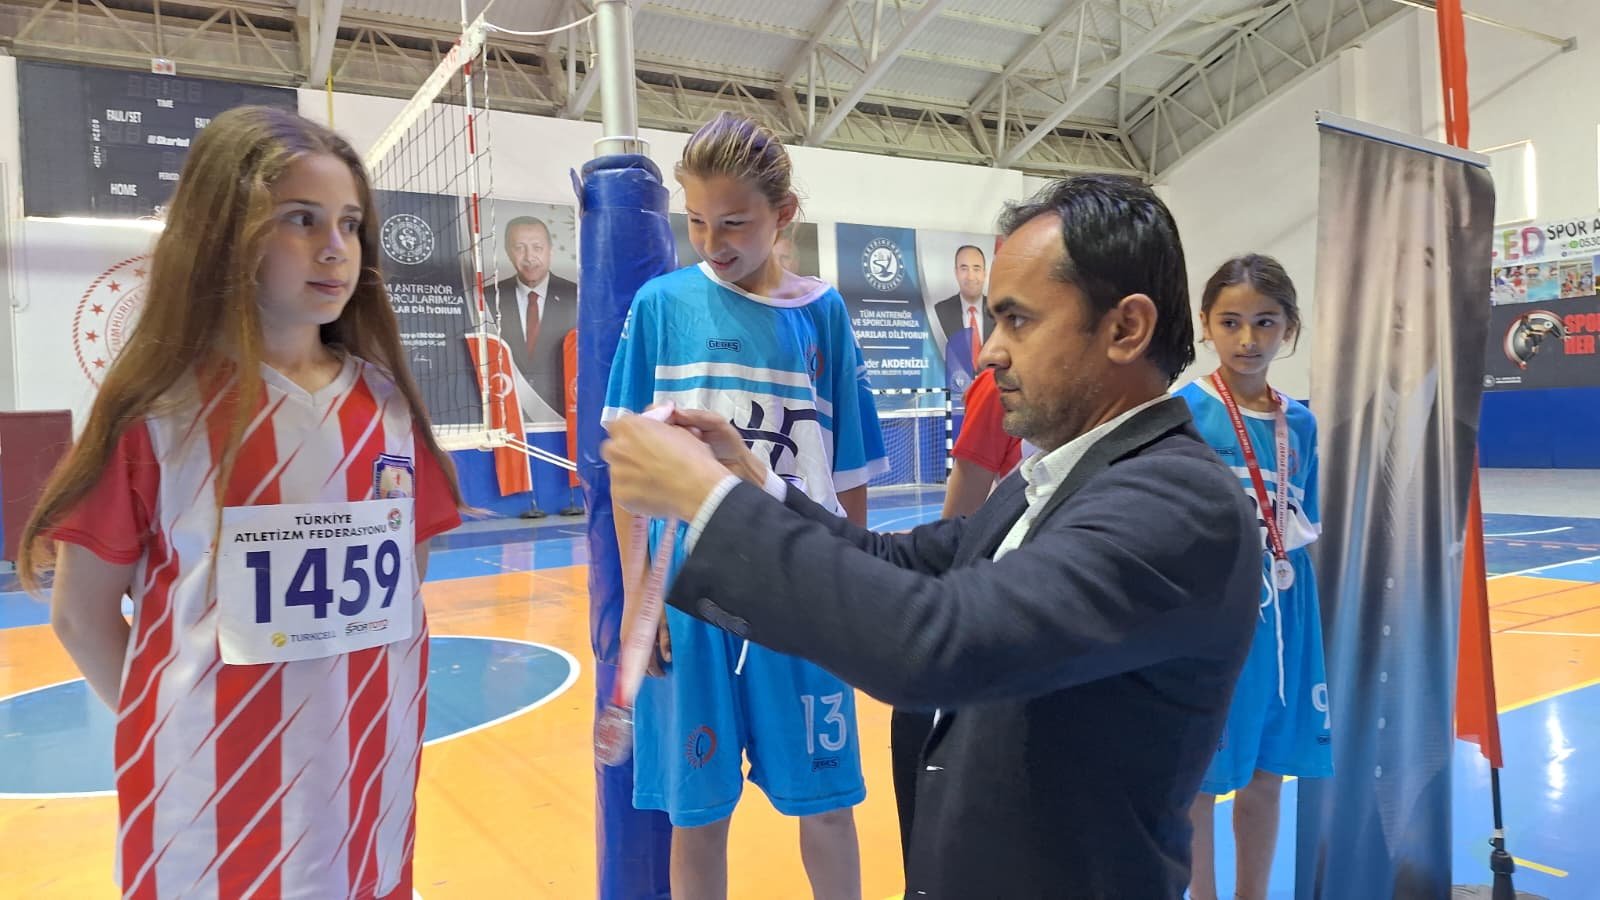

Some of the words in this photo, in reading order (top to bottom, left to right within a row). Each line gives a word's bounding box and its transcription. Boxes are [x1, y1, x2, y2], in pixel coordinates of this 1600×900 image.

[110, 183, 137, 196] HOME
[1547, 221, 1587, 240] SPOR
[395, 284, 453, 294] ANTRENÖR
[387, 293, 464, 305] ORCULARIMIZA
[860, 309, 875, 318] TÜM
[876, 310, 912, 320] ANTRENÖR
[888, 329, 929, 340] DİLİYORUM
[881, 357, 929, 369] AKDENİZLİ
[295, 512, 352, 526] TÜRKİYE
[234, 528, 304, 543] ATLETİZM
[309, 524, 388, 540] FEDERASYONU
[246, 539, 401, 624] 1459
[290, 630, 337, 642] TURKCELL
[801, 691, 847, 755] 13
